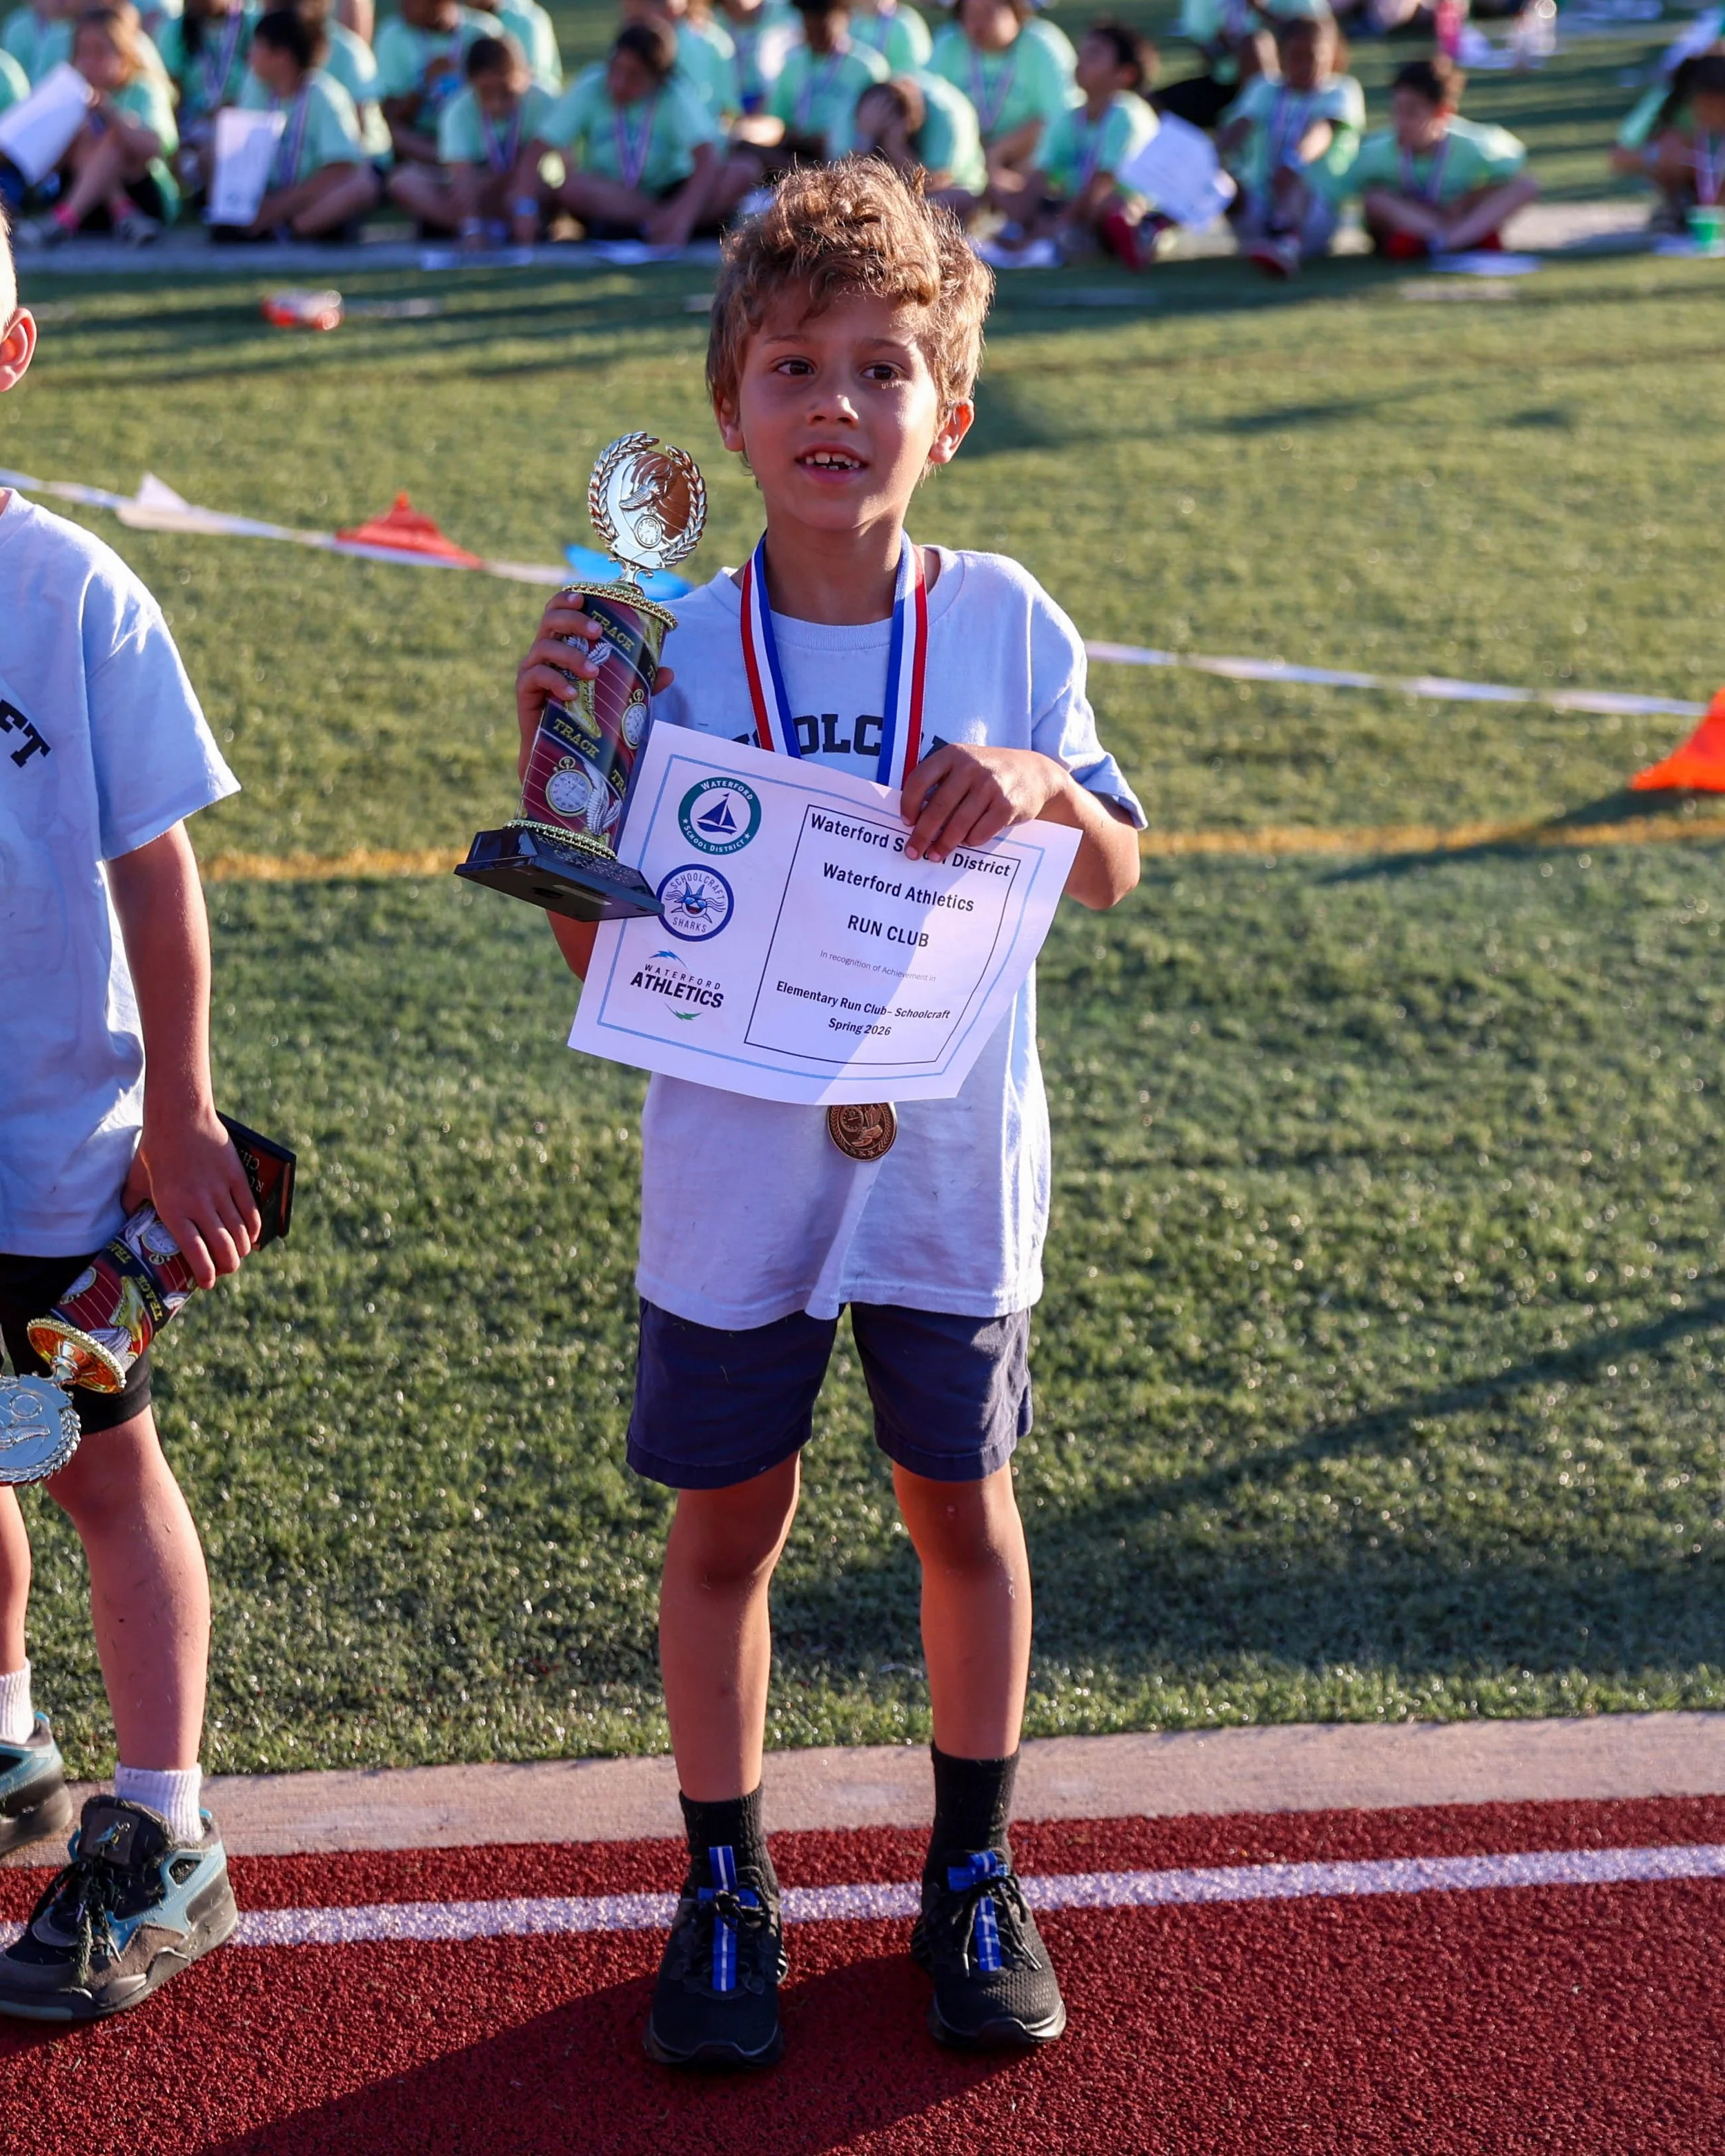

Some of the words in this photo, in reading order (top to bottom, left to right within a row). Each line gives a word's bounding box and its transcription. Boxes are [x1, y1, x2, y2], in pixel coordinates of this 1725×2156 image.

[591, 610, 635, 652] TRACK
[553, 718, 600, 759] TRACK
[700, 780, 753, 800] WATERFORD
[684, 825, 707, 849] SCHOOL
[709, 839, 745, 852] DISTRICT
[811, 813, 889, 848] Waterford
[952, 852, 1011, 876] District
[671, 872, 724, 900] SCHOOLCRAFT
[823, 862, 902, 898] Waterford
[905, 887, 974, 911] Athletics
[673, 917, 707, 933] SHARKS
[847, 915, 883, 936] RUN
[887, 926, 929, 947] CLUB
[644, 964, 721, 990] WATERFORD
[829, 953, 871, 969] recognition
[882, 967, 928, 981] Achievement
[630, 971, 724, 1008] ATHLETICS
[776, 980, 838, 1007] Elementary
[840, 998, 862, 1011] Run
[894, 1007, 951, 1019] Schoolcraft
[828, 1018, 863, 1035] Spring
[864, 1025, 892, 1036] 2026
